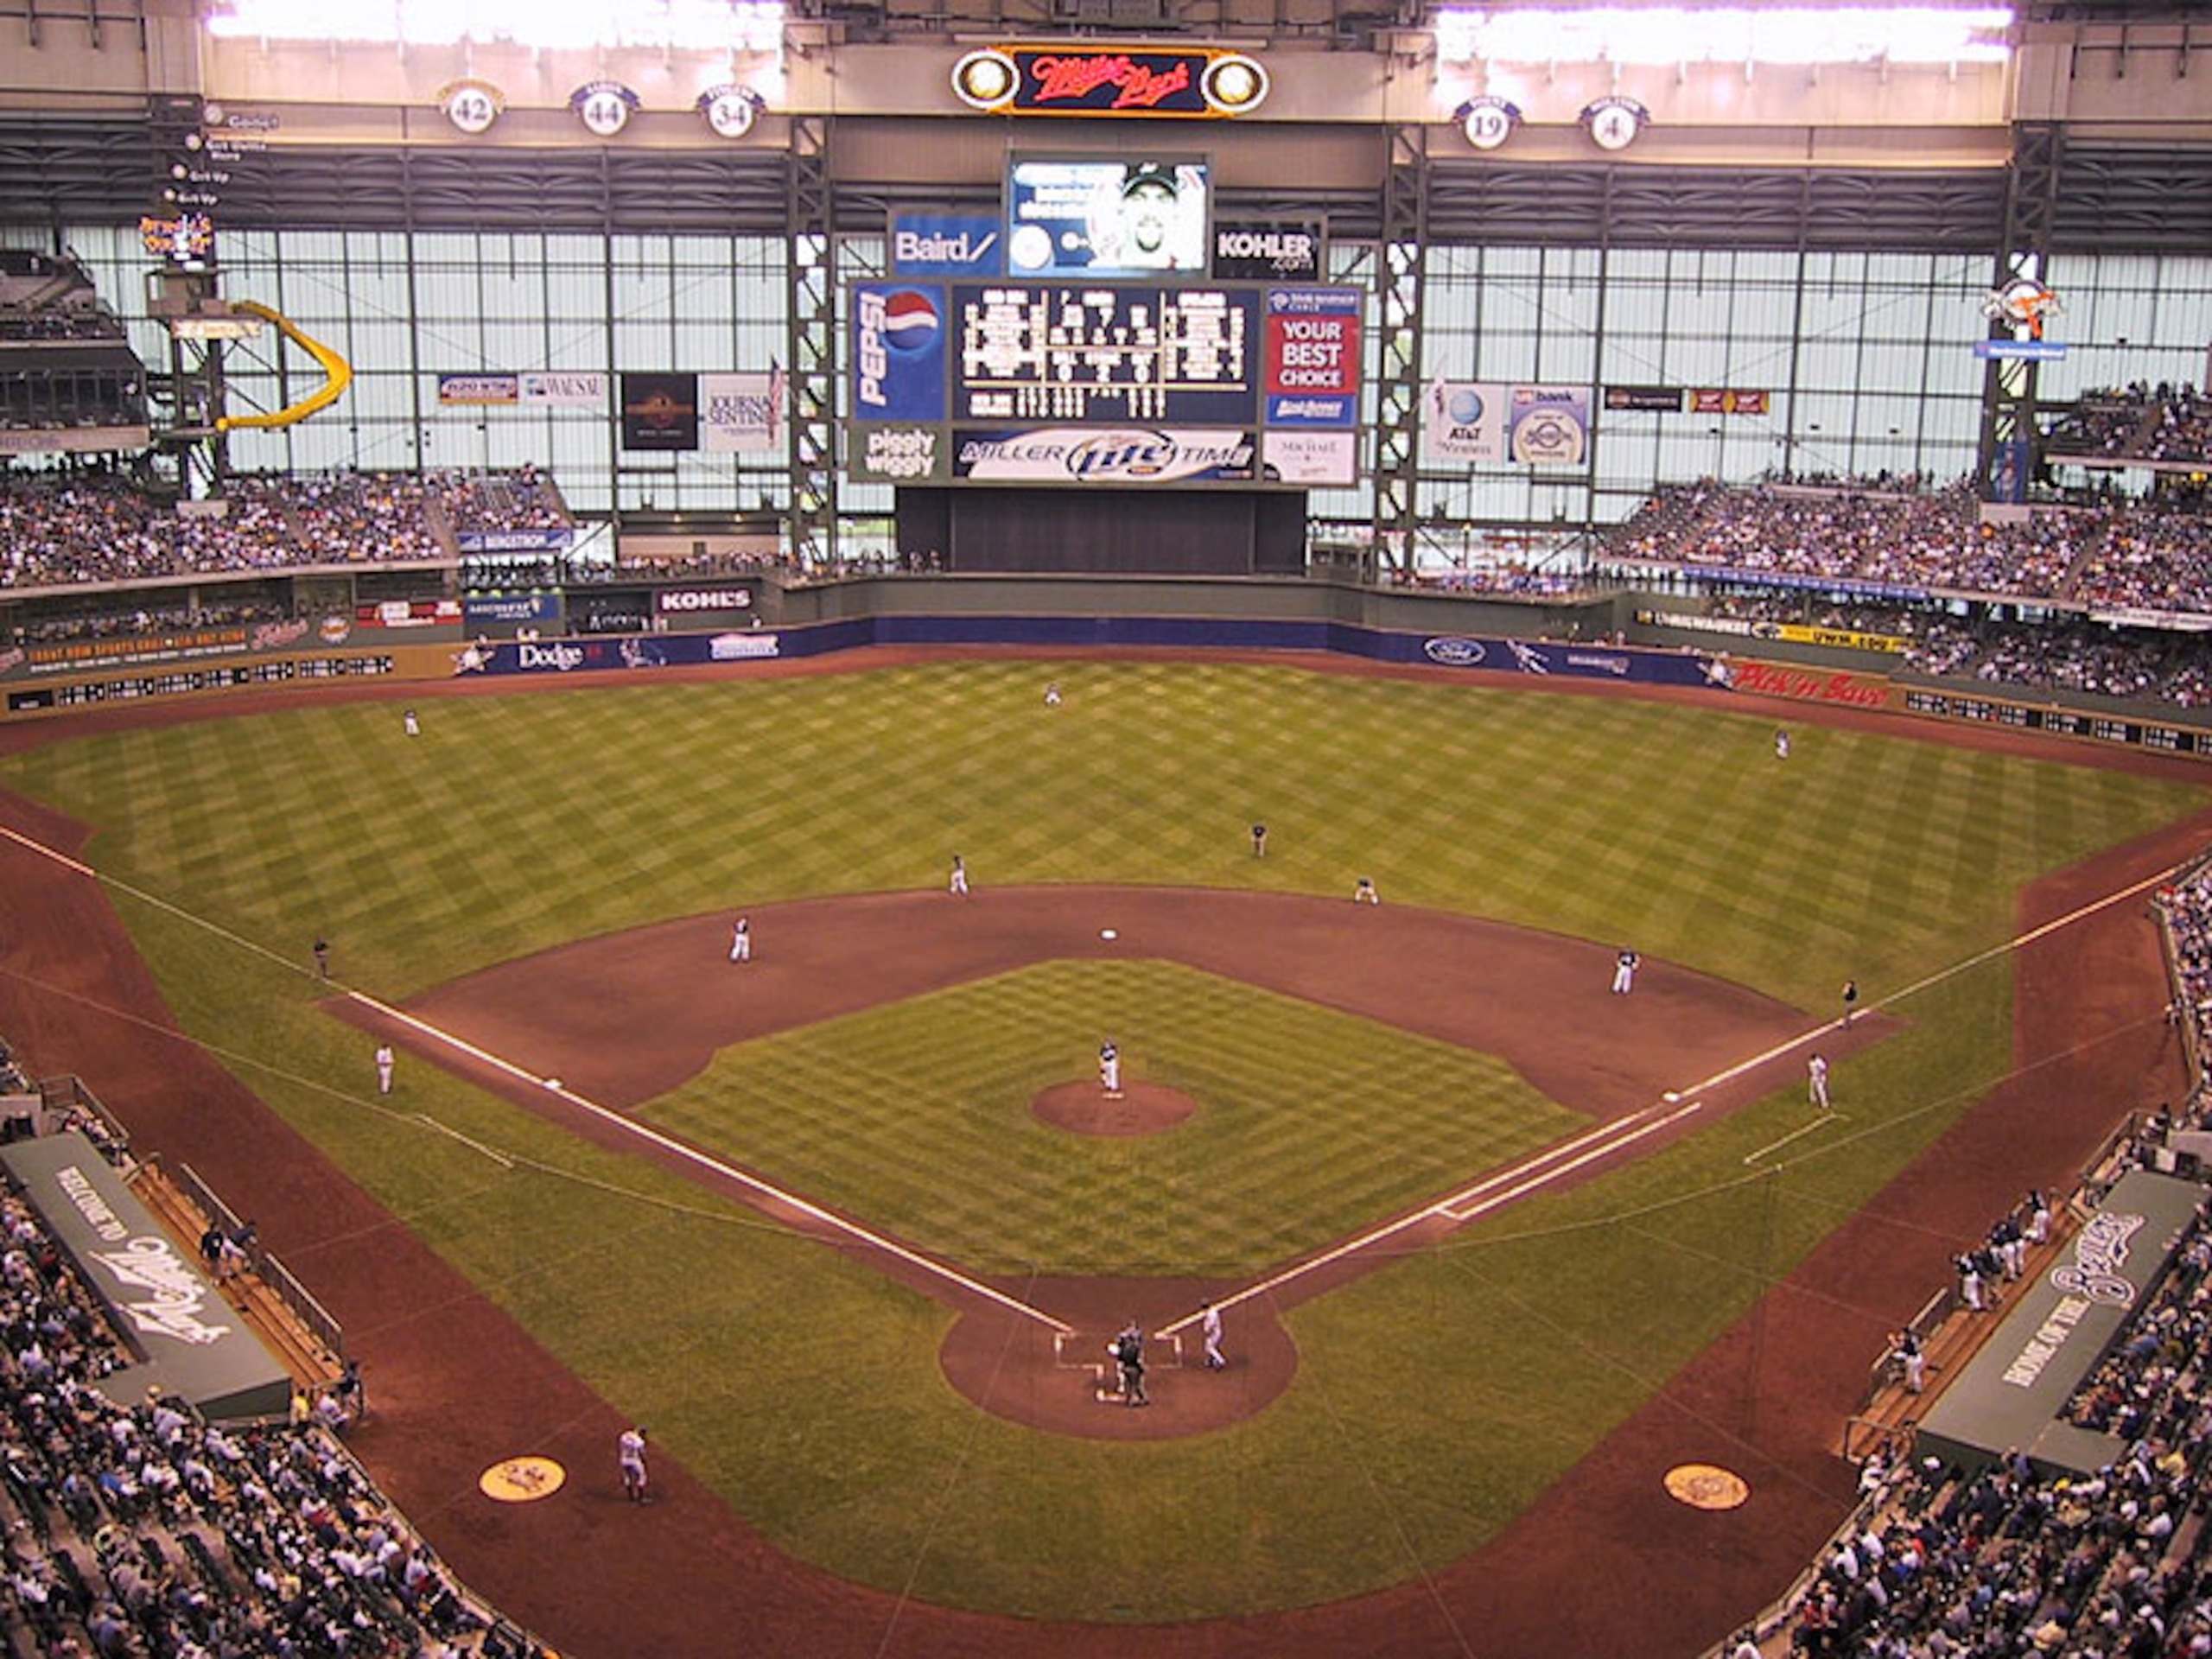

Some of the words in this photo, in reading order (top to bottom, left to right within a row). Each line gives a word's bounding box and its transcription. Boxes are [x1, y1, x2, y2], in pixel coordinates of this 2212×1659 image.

[455, 99, 486, 120] 42
[588, 100, 620, 124] 44
[715, 104, 747, 127] 34
[1474, 115, 1503, 137] 19
[895, 231, 968, 262] Baird
[1217, 232, 1311, 258] KOHLER
[1281, 321, 1343, 340] YOUR
[859, 291, 887, 407] PEPSI
[1281, 342, 1343, 366] BEST
[1279, 369, 1343, 387] CHOICE
[1536, 389, 1573, 403] bank
[868, 428, 936, 456] piggly
[1448, 427, 1483, 441] AT&T
[960, 442, 1065, 461] MILLER
[1182, 445, 1254, 466] TIME
[1438, 442, 1491, 455] Wireless
[865, 450, 936, 478] wiggly
[661, 589, 752, 610] KOHL'S
[518, 642, 585, 671] Dodge
[1821, 674, 1889, 704] Save
[2001, 1338, 2060, 1389] HOME
[2054, 1294, 2093, 1328] THE
